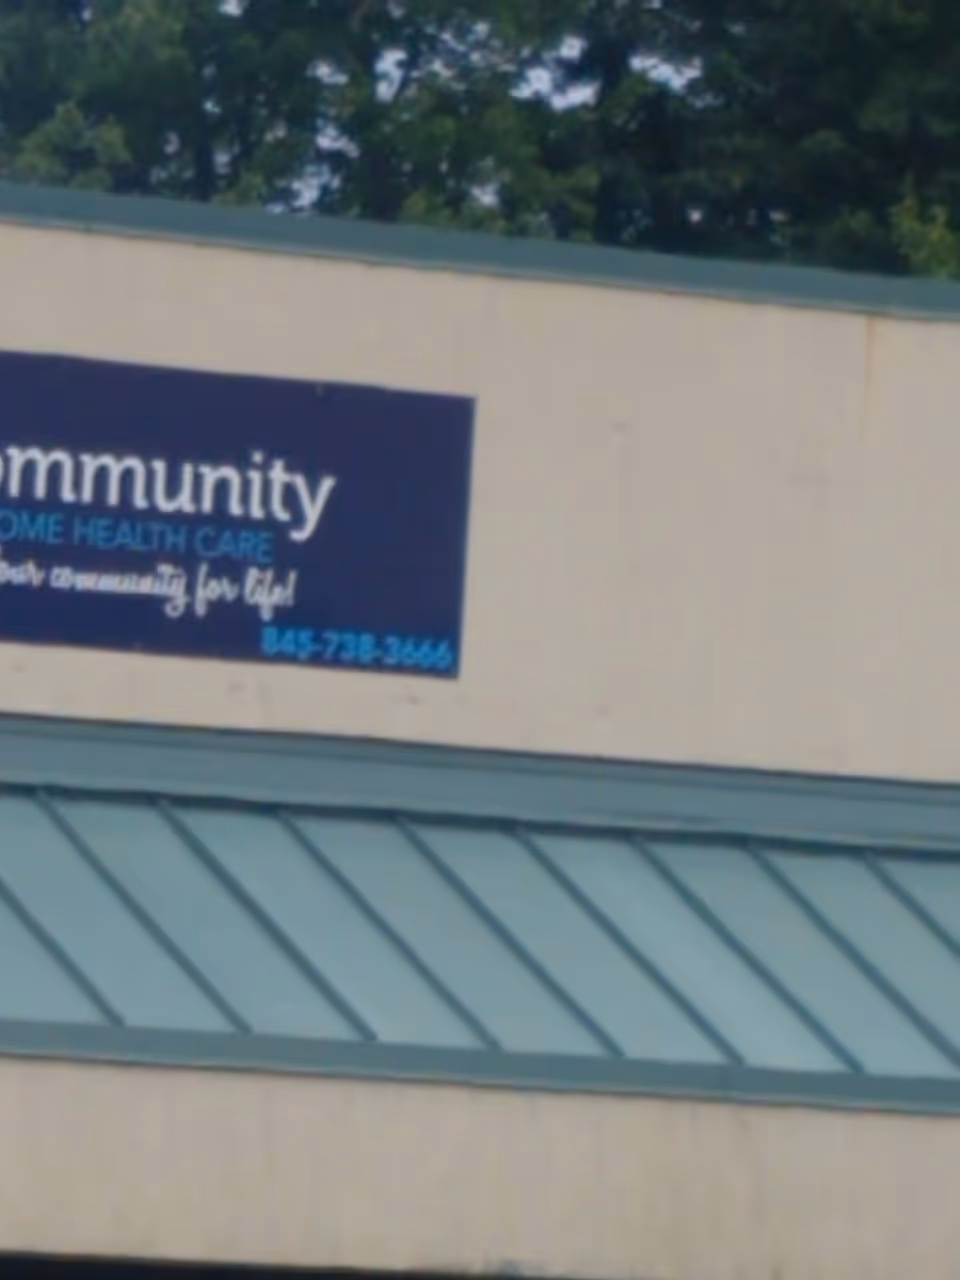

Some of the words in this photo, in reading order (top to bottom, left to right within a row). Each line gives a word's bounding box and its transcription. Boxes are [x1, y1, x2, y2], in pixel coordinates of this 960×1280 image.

[74, 516, 185, 554] HEALTH
[196, 528, 275, 564] CARE
[50, 562, 187, 617] community
[194, 563, 238, 615] for
[245, 567, 298, 619] life!
[261, 626, 454, 670] 845-738-3666
